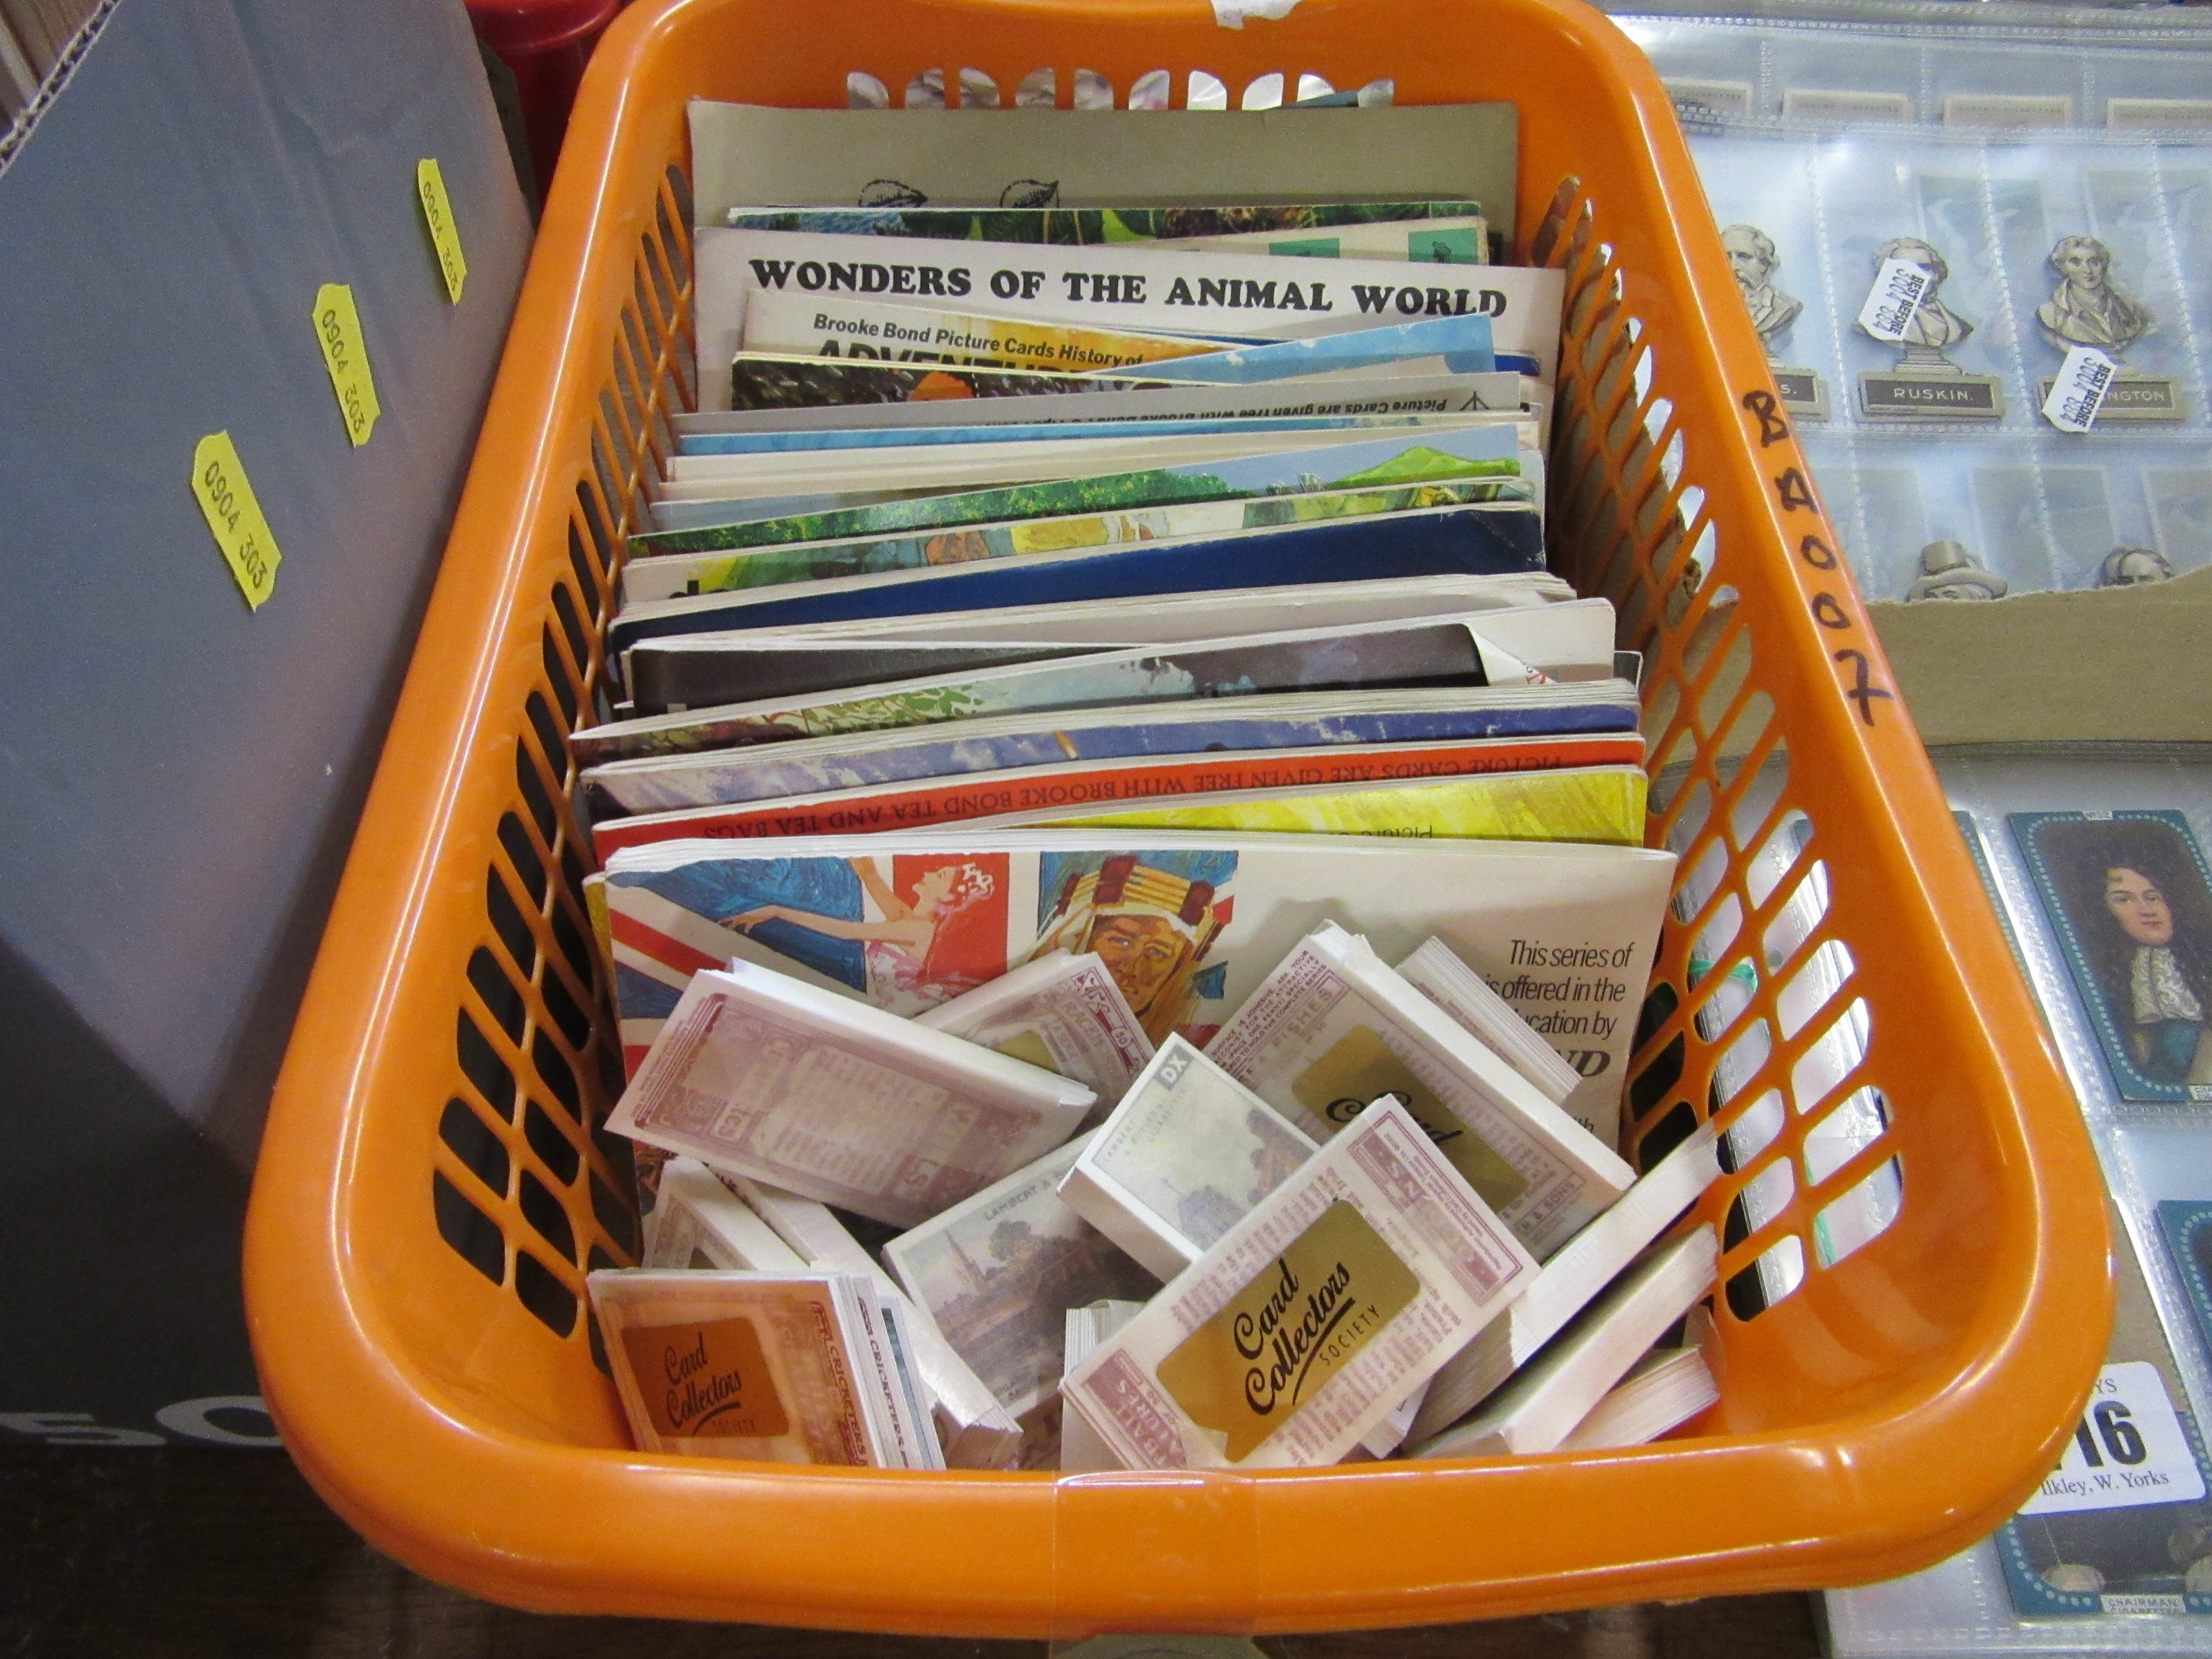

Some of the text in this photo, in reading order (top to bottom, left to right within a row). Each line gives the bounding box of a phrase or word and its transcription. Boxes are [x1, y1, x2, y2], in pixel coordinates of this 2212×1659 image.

[423, 181, 459, 290] 0904 303
[750, 259, 1508, 317] WONDERS OF THE ANIMAL WORLD
[1887, 273, 1925, 336] BEST BEFORE
[814, 313, 880, 337] Brooke
[883, 322, 931, 342] Bond
[935, 328, 1000, 352] Picture
[1004, 337, 1055, 359] Cards
[1059, 344, 1122, 367] History
[323, 309, 367, 434] 0904 303
[1893, 388, 1974, 401] RUSKIN.
[2072, 363, 2112, 428] BEST BEFORE
[1273, 404, 1313, 417] given
[1317, 405, 1341, 415] are
[1342, 400, 1389, 415] Cards
[1392, 397, 1448, 411] Picture
[204, 461, 268, 589] 0904 303
[703, 756, 1560, 846] PICTURE CARDS ARE GIVEN FREE WITH BROOKE BOND TEA AND TEA BAGS
[1284, 958, 1321, 998] SPECIALLY
[1290, 949, 1309, 969] YOUR
[1510, 939, 1635, 968] This series of
[1213, 1030, 1244, 1065] ACCONIST
[1258, 998, 1274, 1015] THE
[1273, 953, 1315, 998] ATTRACTIVE
[1275, 985, 1307, 1019] COMPLETE
[1304, 962, 1327, 987] SERIES
[1502, 975, 1572, 1002] offered
[1572, 977, 1591, 1001] in
[1593, 977, 1626, 1002] the
[1592, 1011, 1618, 1040] by
[1158, 1051, 1189, 1084] DX
[1234, 1258, 1299, 1359] Card
[1319, 1304, 1380, 1366] SOCIETY
[665, 1332, 708, 1385] Card
[1246, 1262, 1350, 1416] Collectors
[666, 1370, 742, 1428] Collectors
[821, 1344, 875, 1456] CRICKETERS
[861, 1338, 914, 1448] CRICKETERS
[2094, 1475, 2120, 1491] W.
[2123, 1470, 2169, 1489] Yorks
[2108, 1598, 2179, 1607] CHAIRMAN
